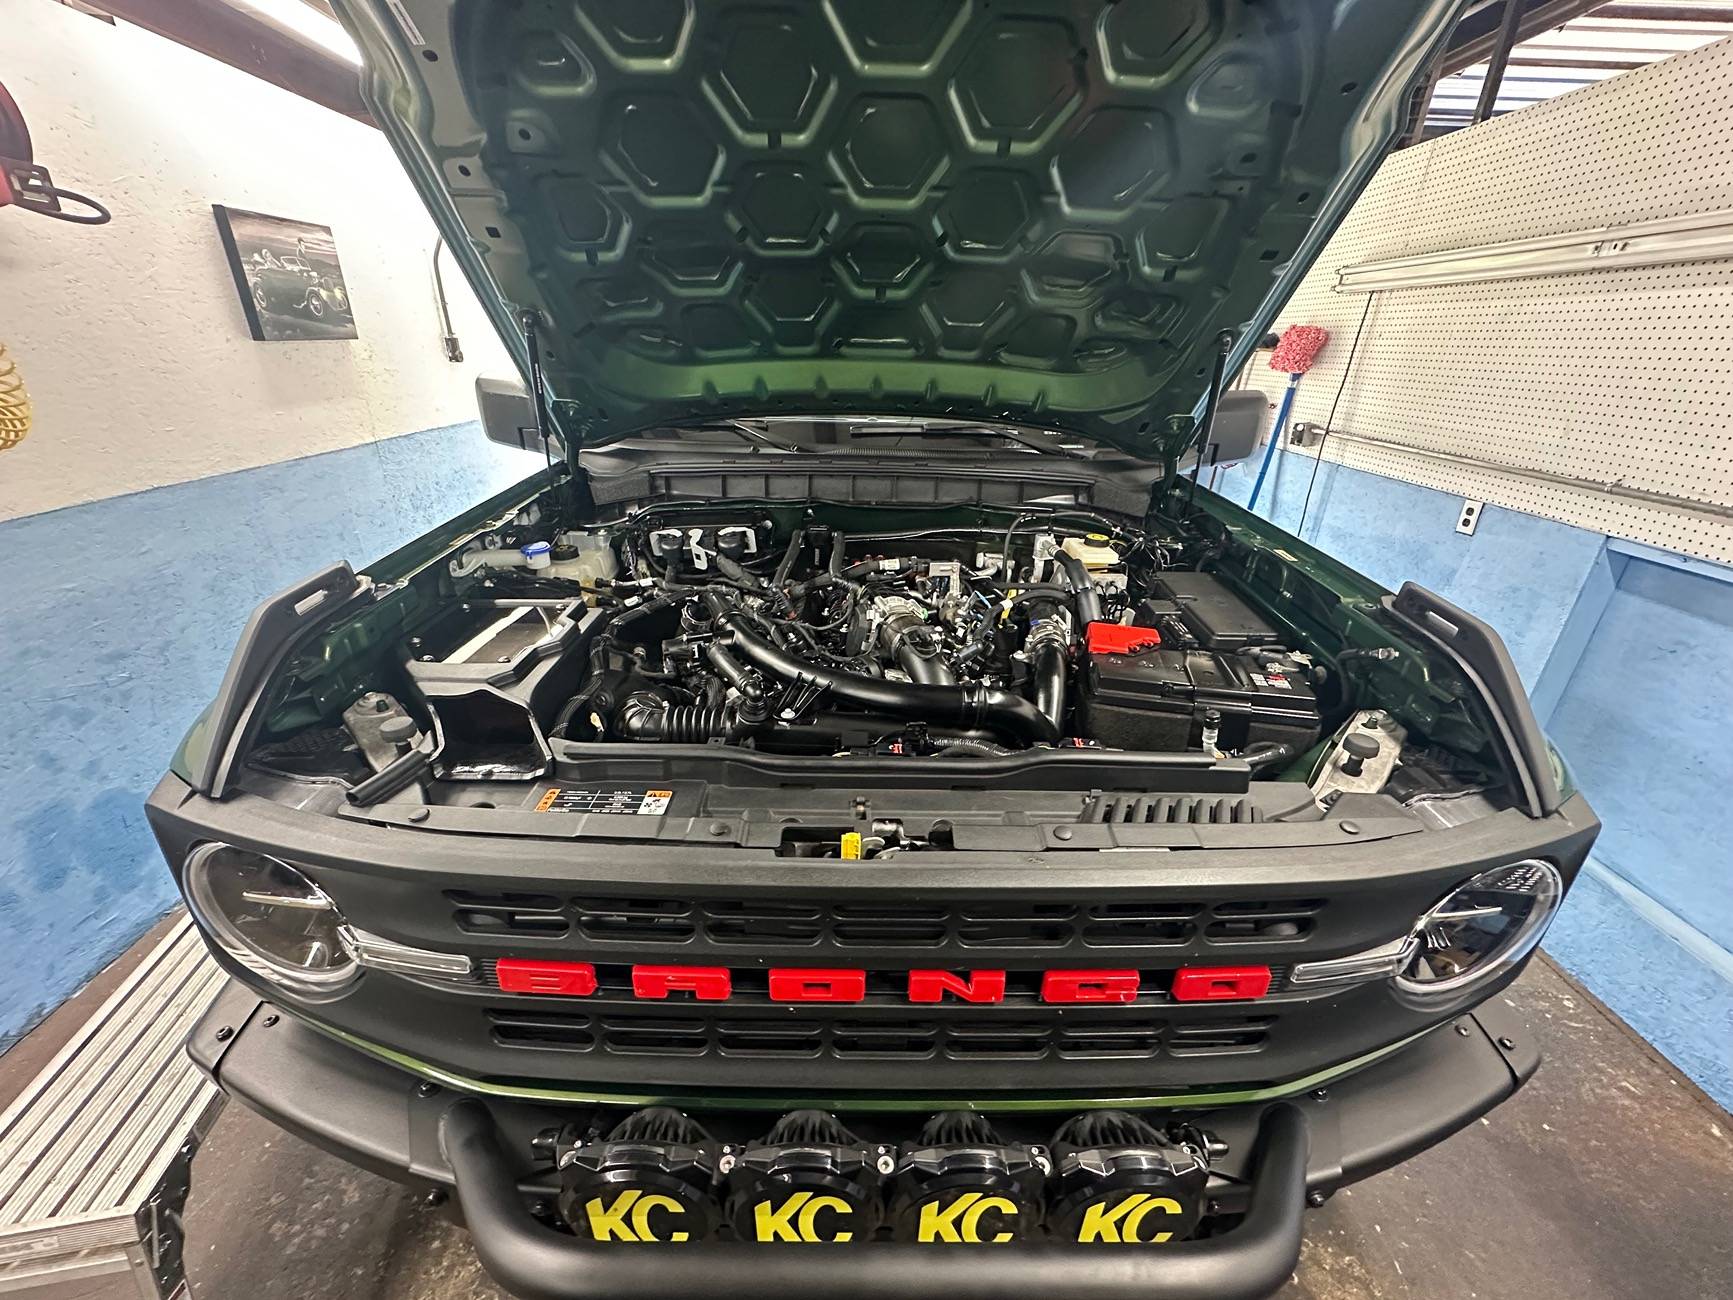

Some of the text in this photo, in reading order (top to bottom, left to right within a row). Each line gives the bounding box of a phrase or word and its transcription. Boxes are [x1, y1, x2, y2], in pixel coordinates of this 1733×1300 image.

[496, 959, 1272, 1003] BRONCO
[585, 1190, 689, 1242] KC
[754, 1192, 853, 1243] KC
[917, 1193, 1016, 1243] KC
[1078, 1194, 1182, 1243] KC
